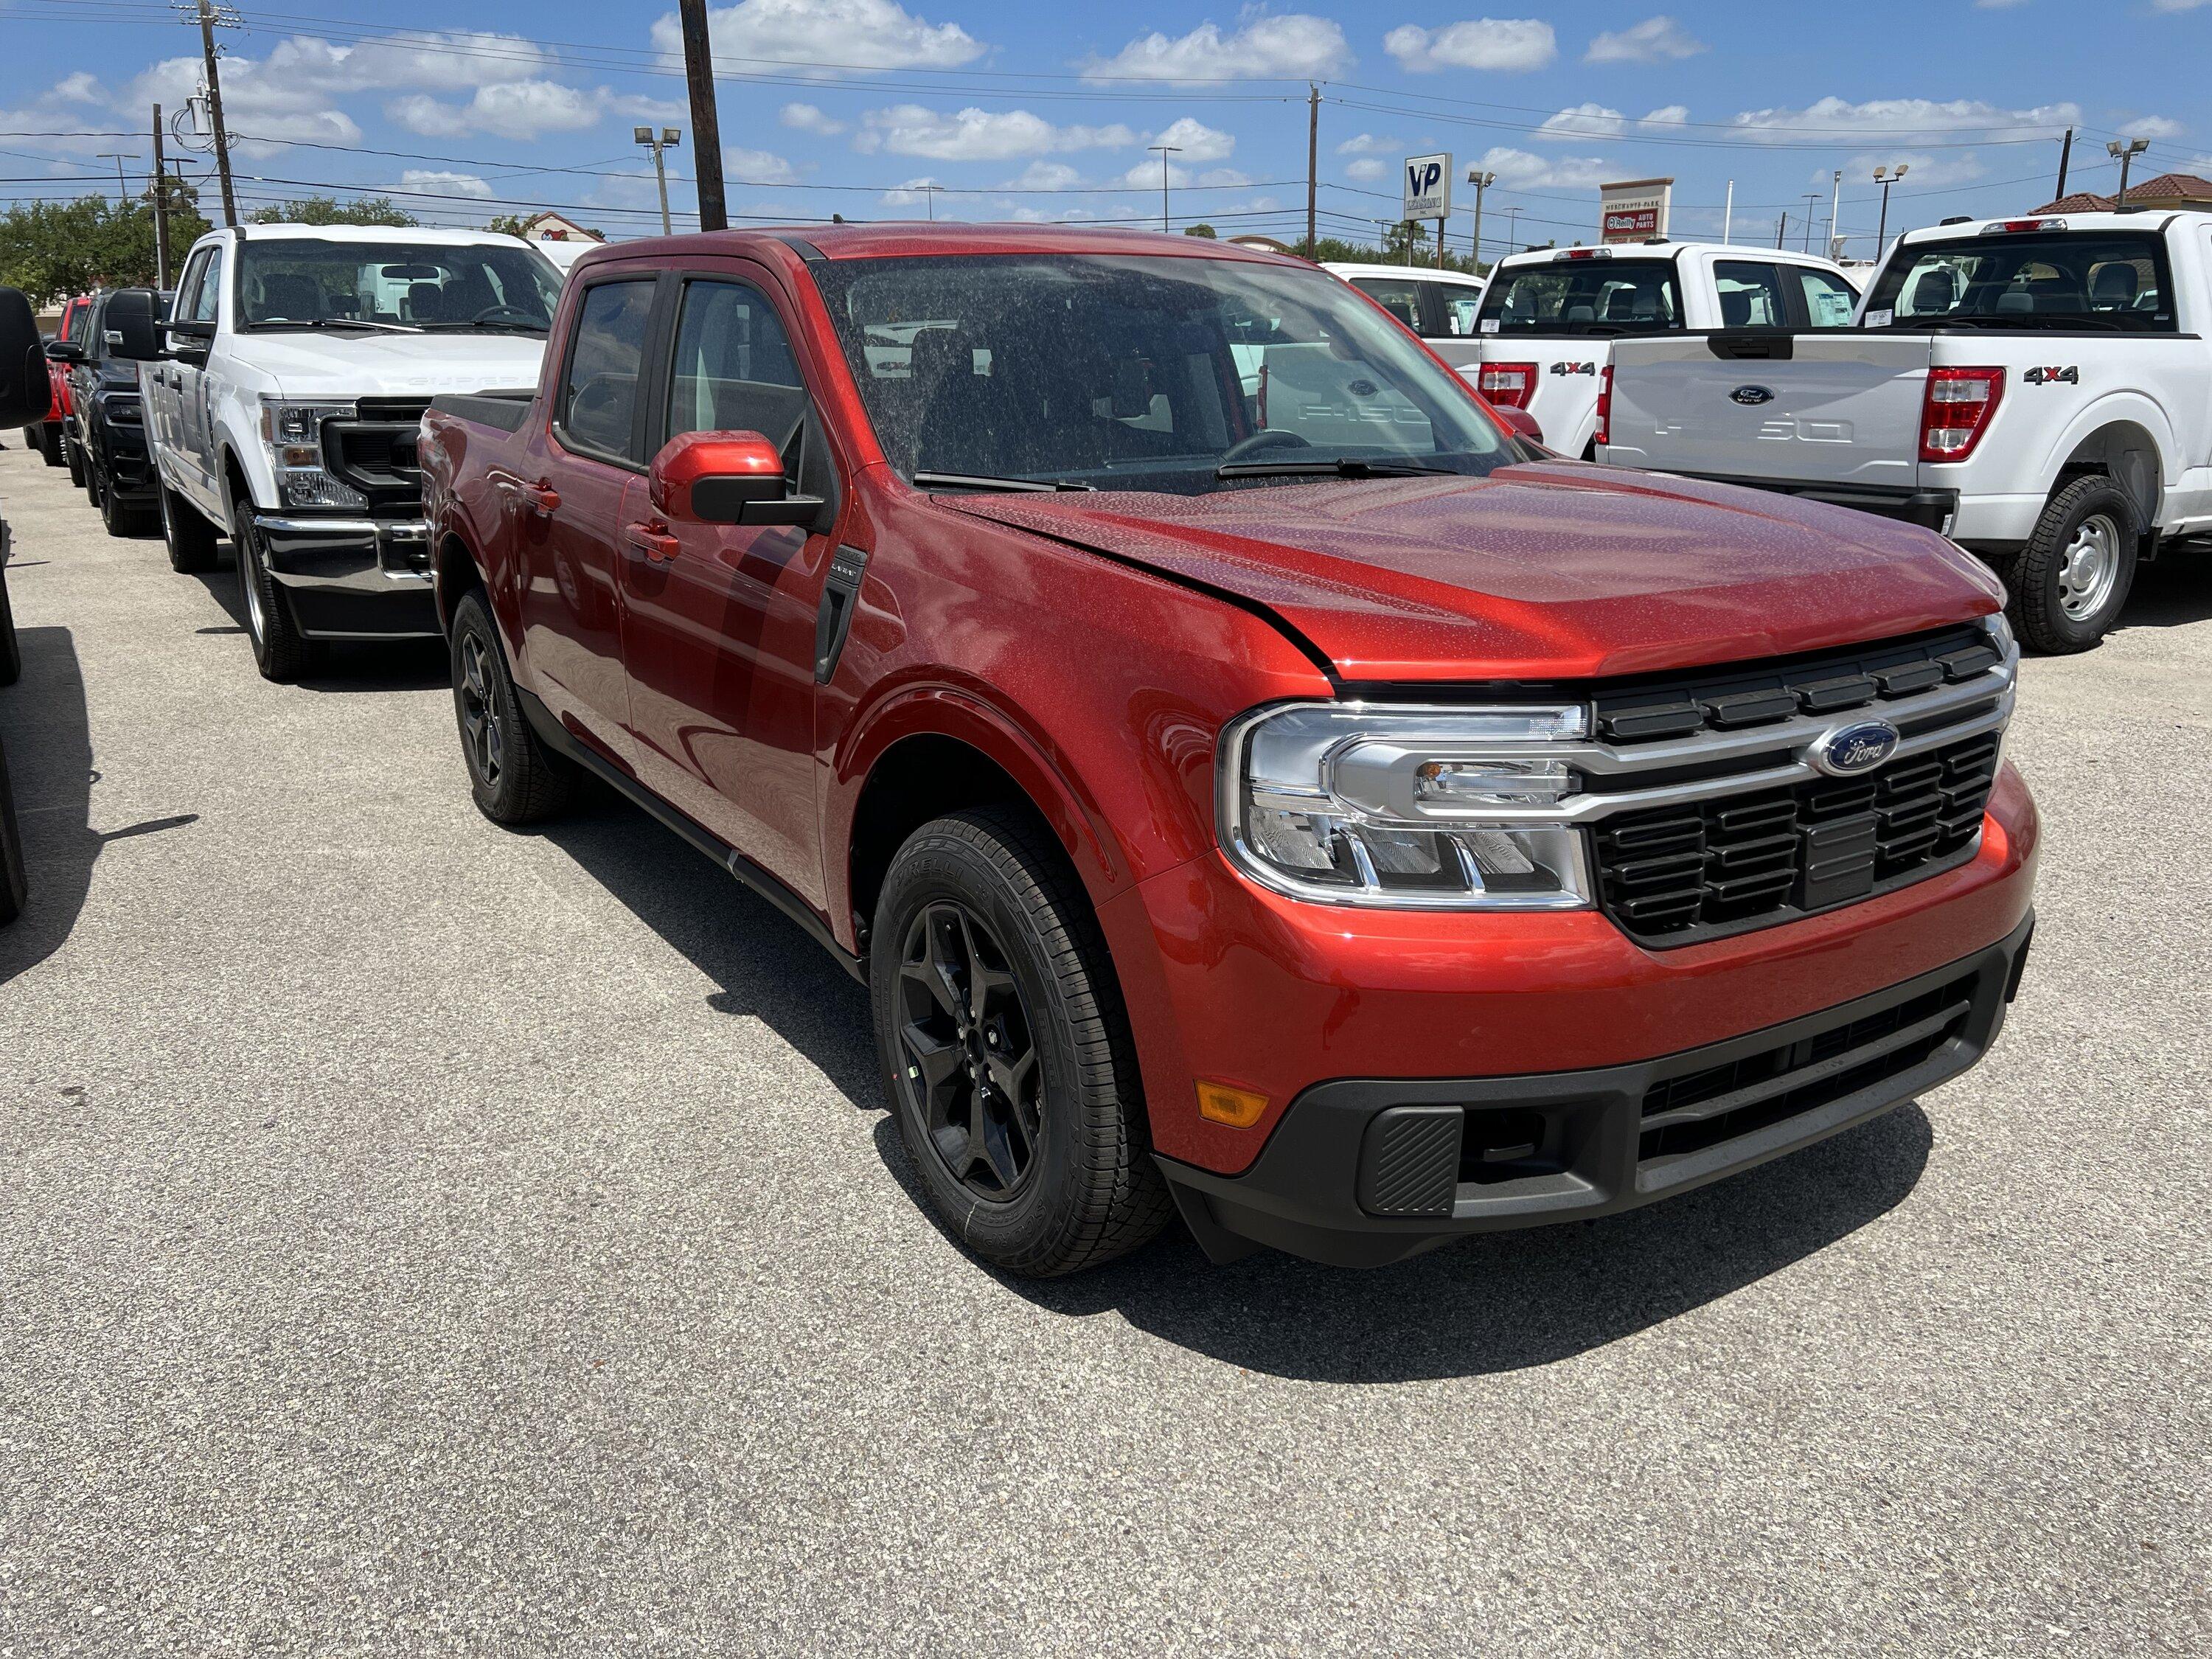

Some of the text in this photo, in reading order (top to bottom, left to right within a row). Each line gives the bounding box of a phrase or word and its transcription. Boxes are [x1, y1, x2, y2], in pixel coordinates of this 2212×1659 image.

[1406, 195, 1442, 209] LEASING
[1644, 201, 1660, 209] PARK
[1638, 213, 1654, 221] AUTO
[1607, 216, 1635, 230] O'Reilly
[1636, 220, 1655, 229] PARTS
[1843, 733, 1885, 765] Ford
